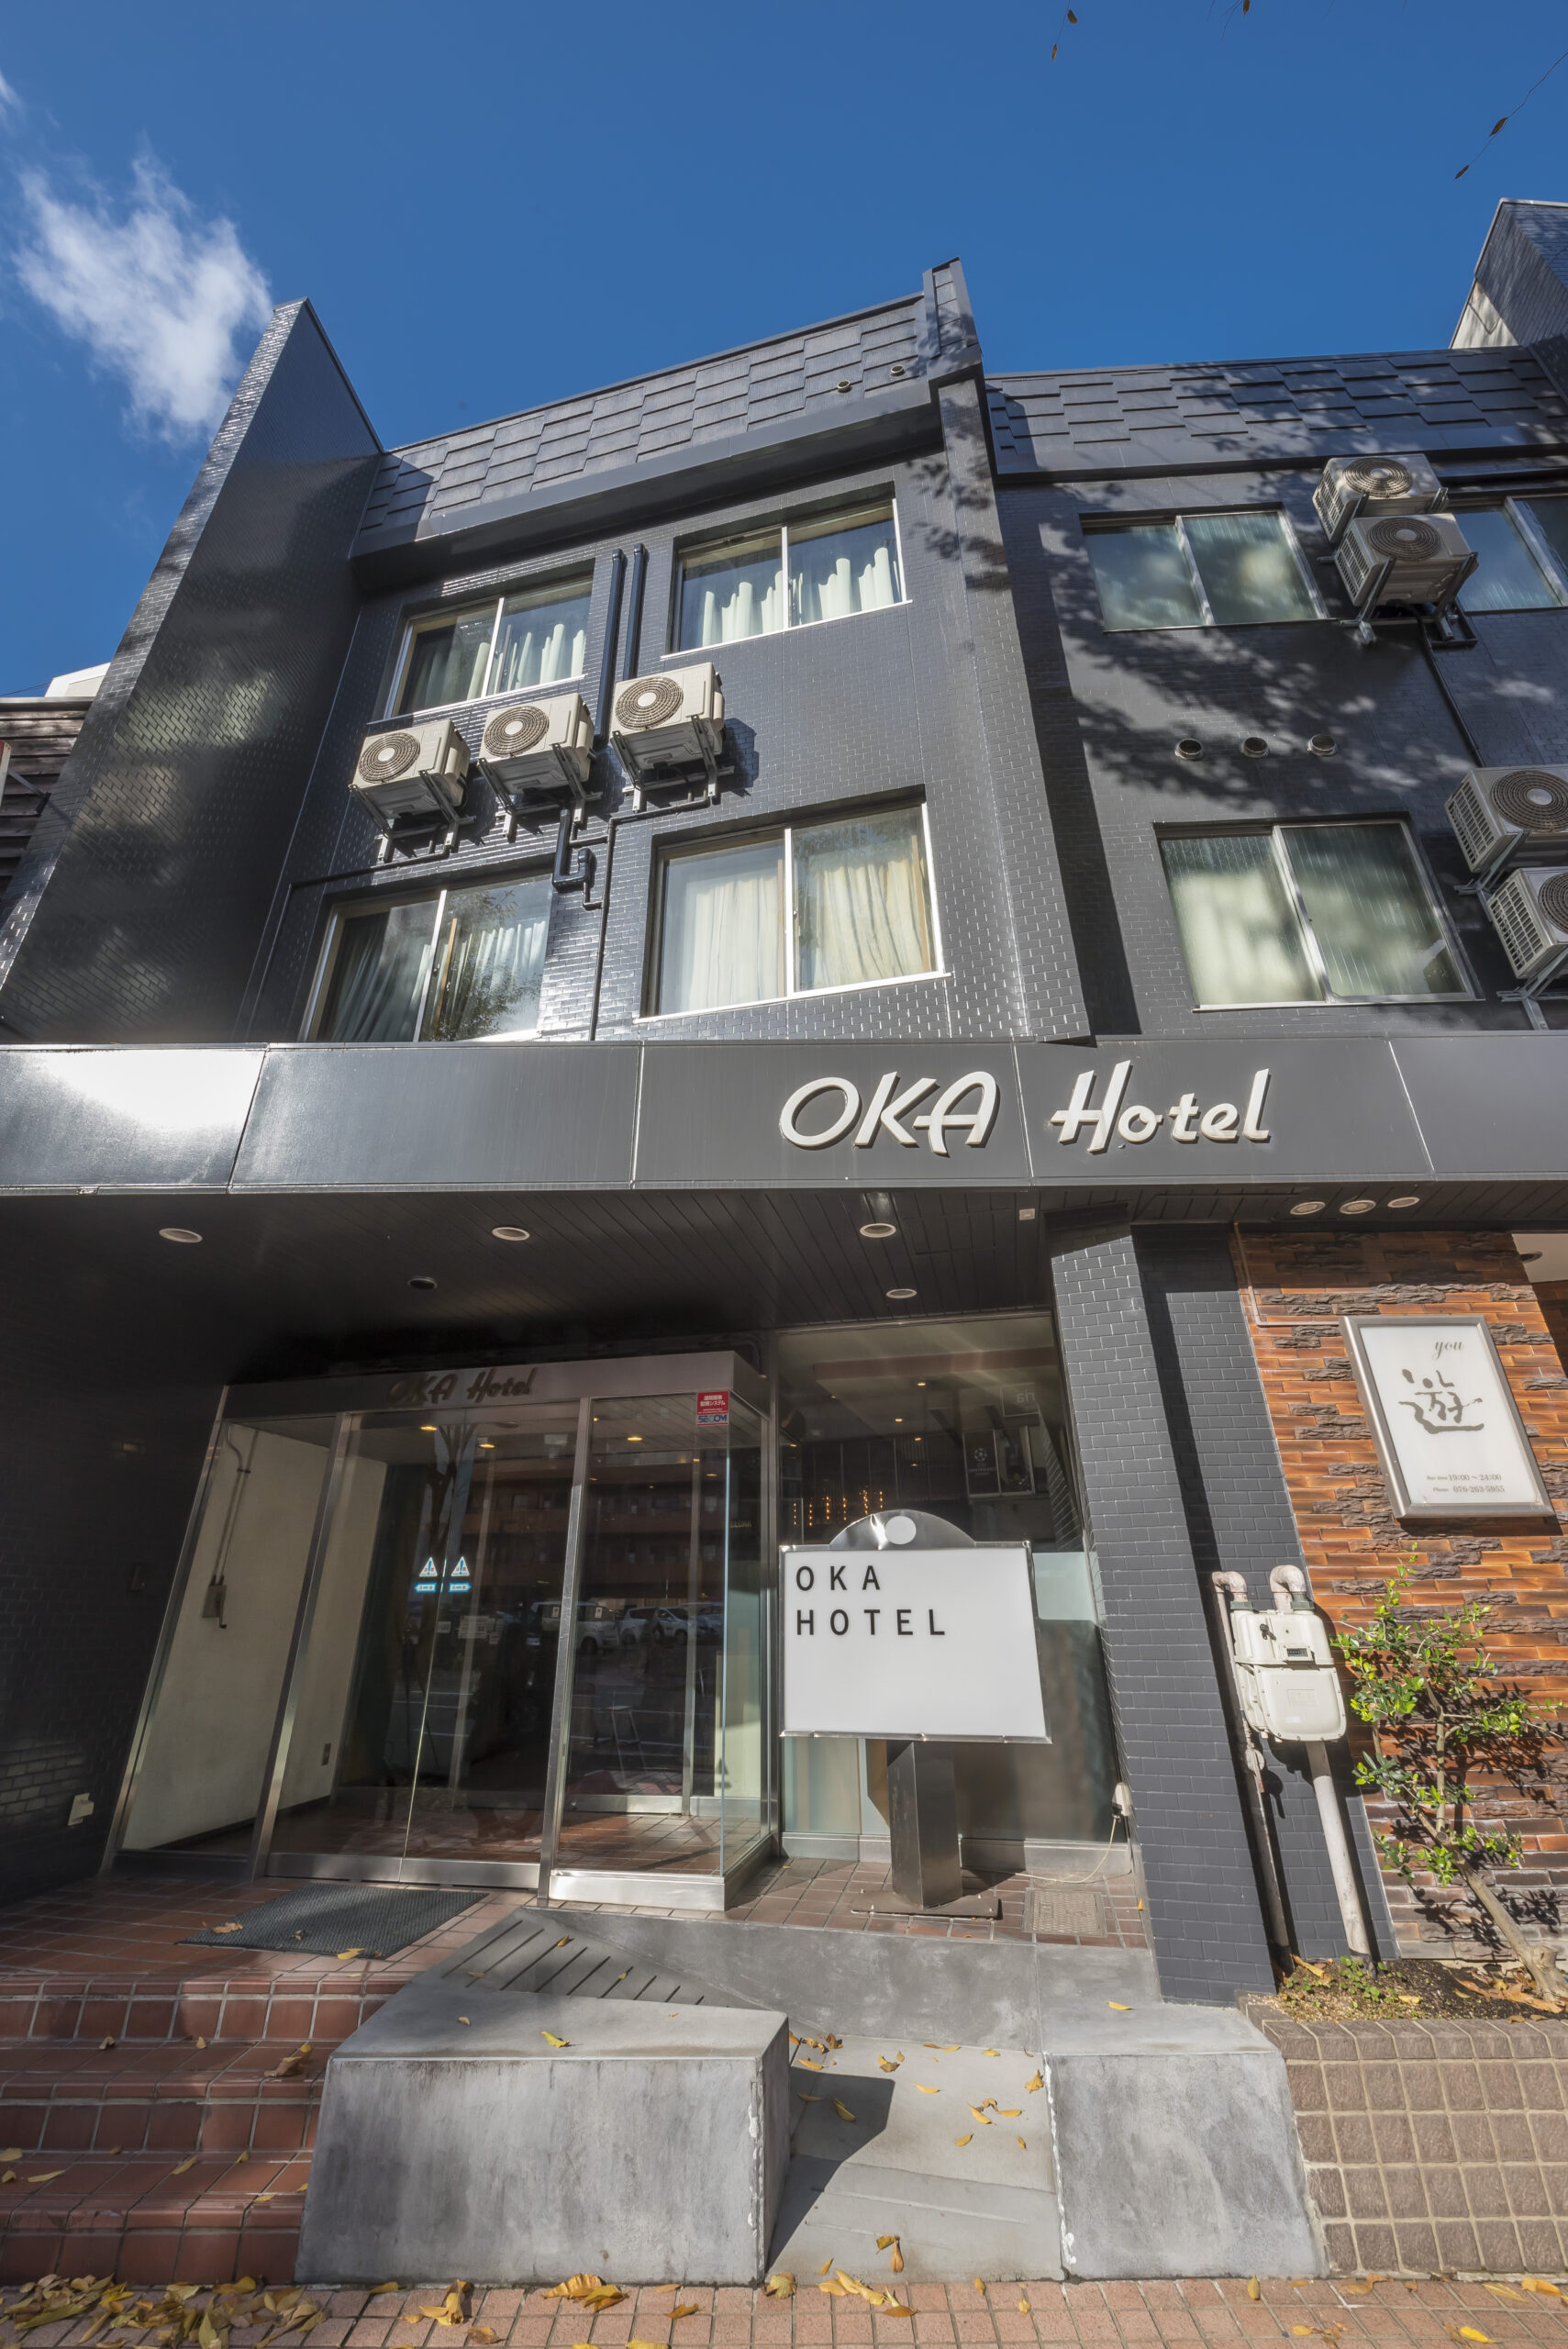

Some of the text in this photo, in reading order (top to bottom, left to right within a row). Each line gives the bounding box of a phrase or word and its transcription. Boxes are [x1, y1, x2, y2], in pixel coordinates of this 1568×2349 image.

[778, 1059, 1271, 1156] OKA Hotel
[1434, 1340, 1465, 1360] you
[386, 1366, 539, 1405] OKA Hotel
[698, 1414, 728, 1423] SECOM
[795, 1564, 881, 1592] OKA
[795, 1608, 946, 1637] HOTEL
